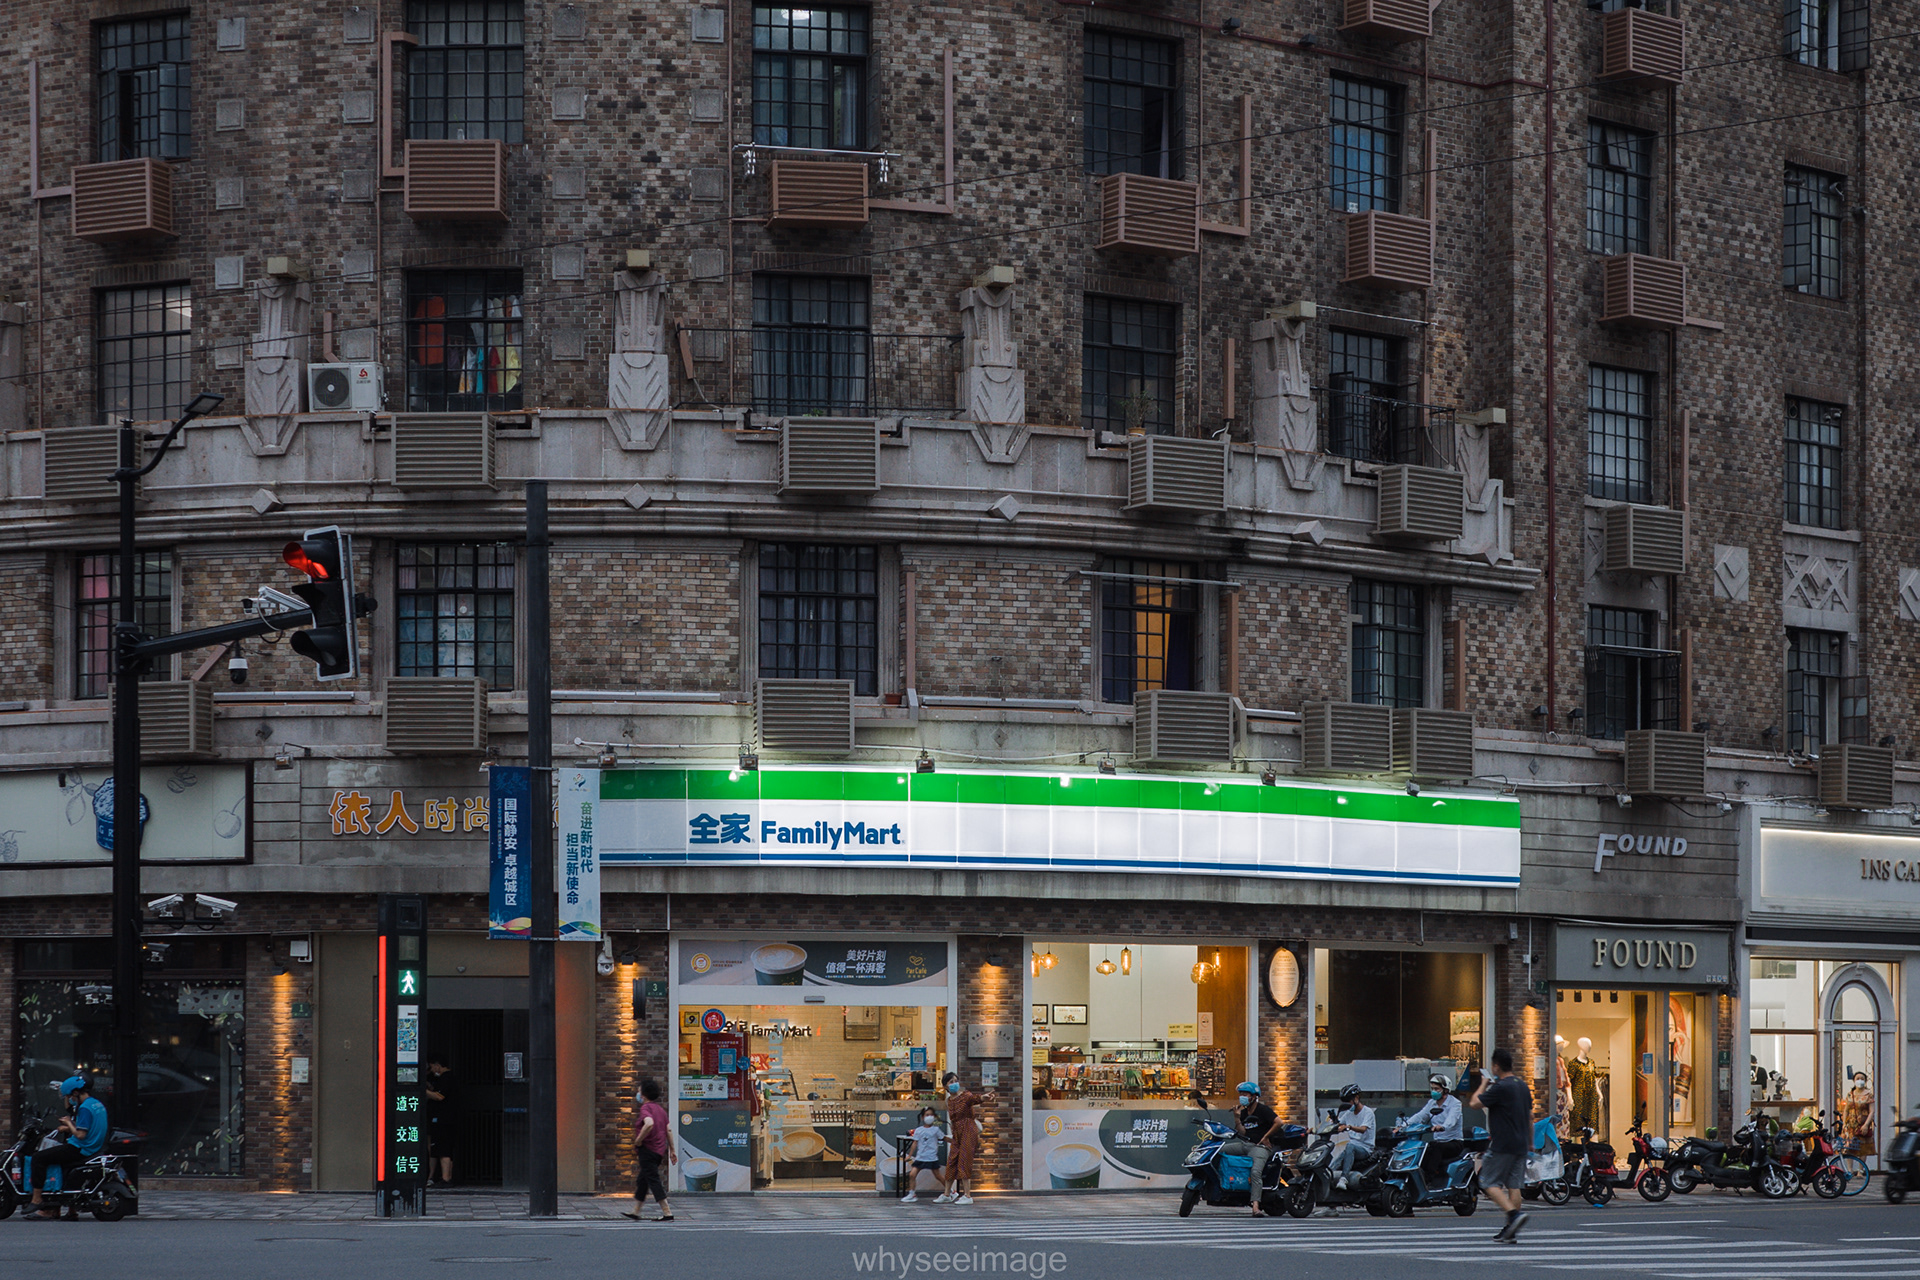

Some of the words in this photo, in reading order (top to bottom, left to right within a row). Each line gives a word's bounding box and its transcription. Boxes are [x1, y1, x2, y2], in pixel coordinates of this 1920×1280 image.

[504, 798, 517, 850] 国际静安
[580, 801, 593, 873] 奋进新时代
[689, 813, 751, 844] 全家
[761, 821, 901, 850] FamilyMart
[1593, 833, 1688, 873] FOUND
[504, 854, 517, 906] 卓越城区
[566, 833, 579, 905] 担当新使命
[1861, 858, 1891, 881] INS
[1894, 859, 1920, 882] CA
[846, 950, 887, 961] 美好片刻
[1594, 938, 1697, 969] FOUND
[652, 983, 658, 992] 3
[751, 1024, 812, 1038] FamiyMart
[764, 1018, 789, 1150] FamilyMart
[396, 1095, 419, 1112] 遵守
[396, 1126, 419, 1142] 交通
[1133, 1119, 1169, 1131] 美好片刻
[395, 1156, 420, 1173] 信号
